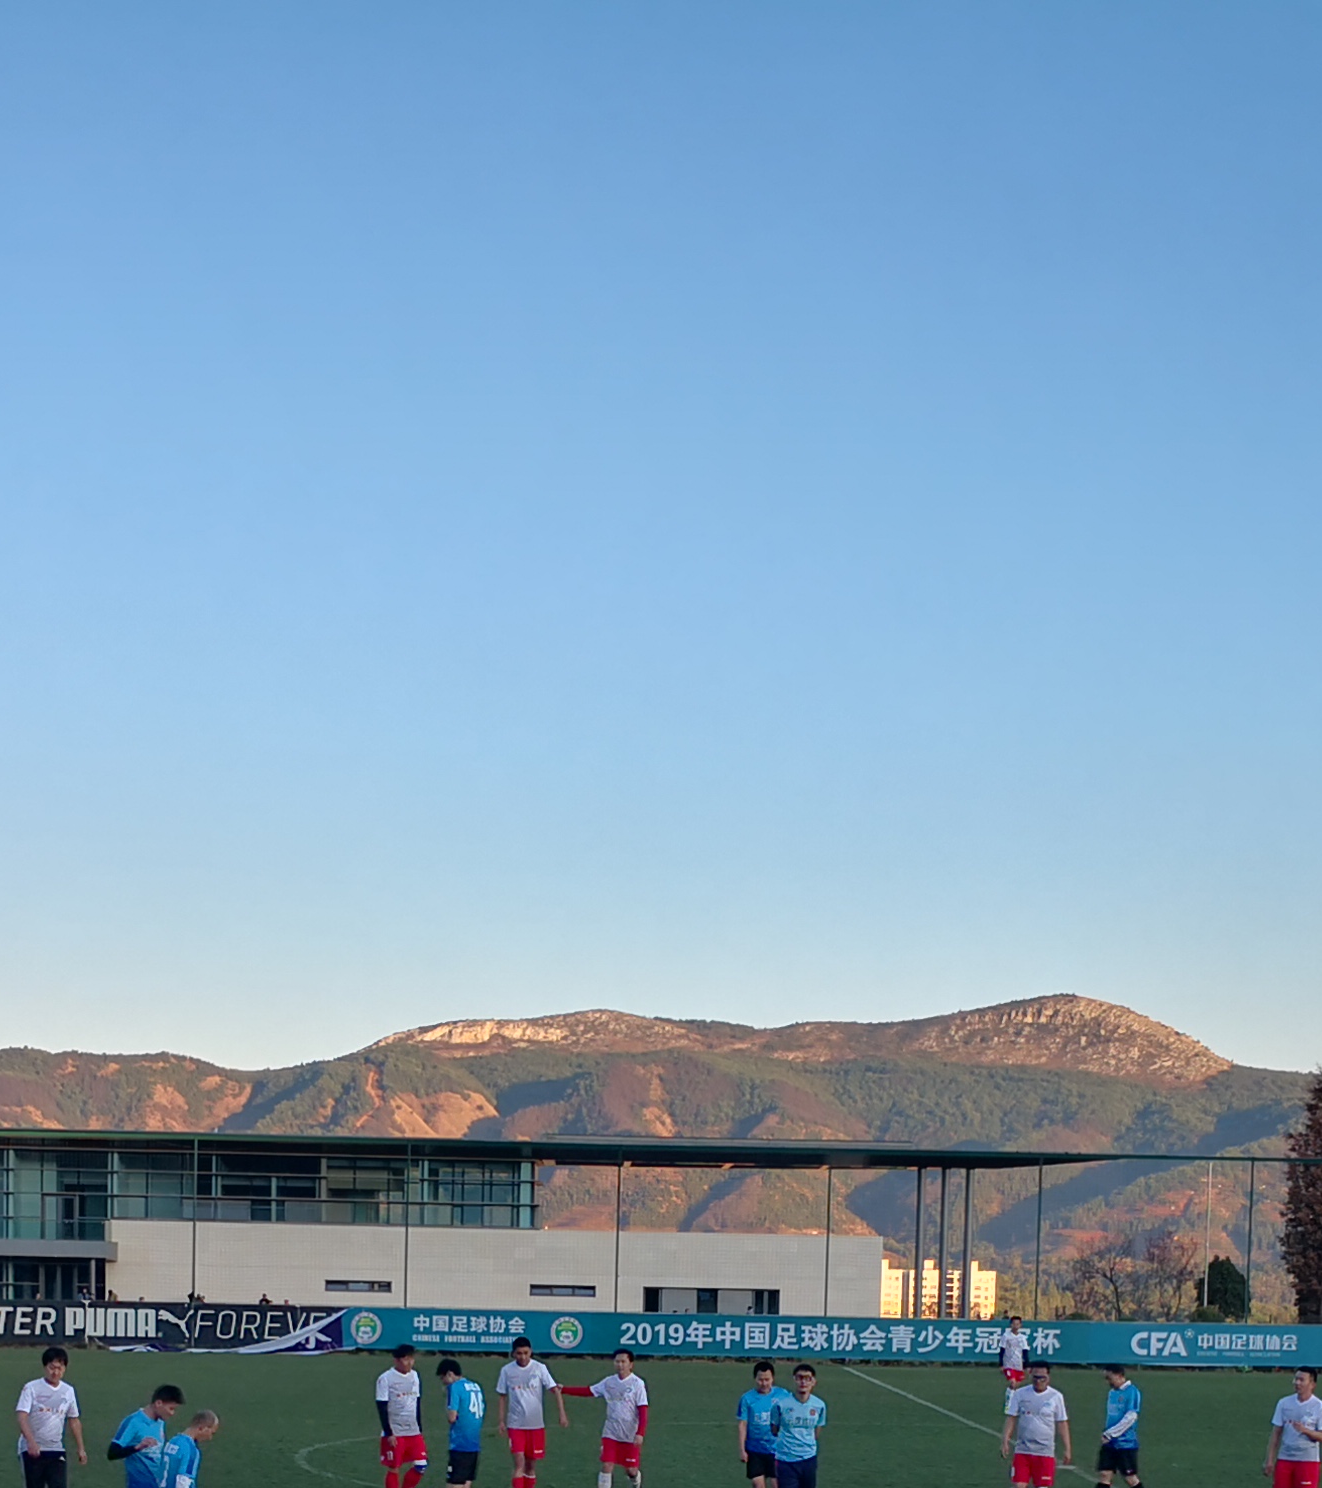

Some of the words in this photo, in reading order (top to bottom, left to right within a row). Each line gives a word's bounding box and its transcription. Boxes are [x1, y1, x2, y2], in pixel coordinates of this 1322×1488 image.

[64, 1306, 156, 1337] PUMA
[194, 1310, 327, 1340] FOREV
[412, 1313, 526, 1334] 中国足球协会
[619, 1321, 1062, 1355] 2019年中国足球协会青少年冠杯
[1130, 1331, 1188, 1356] CFA
[1197, 1333, 1298, 1351] 中国足球协会
